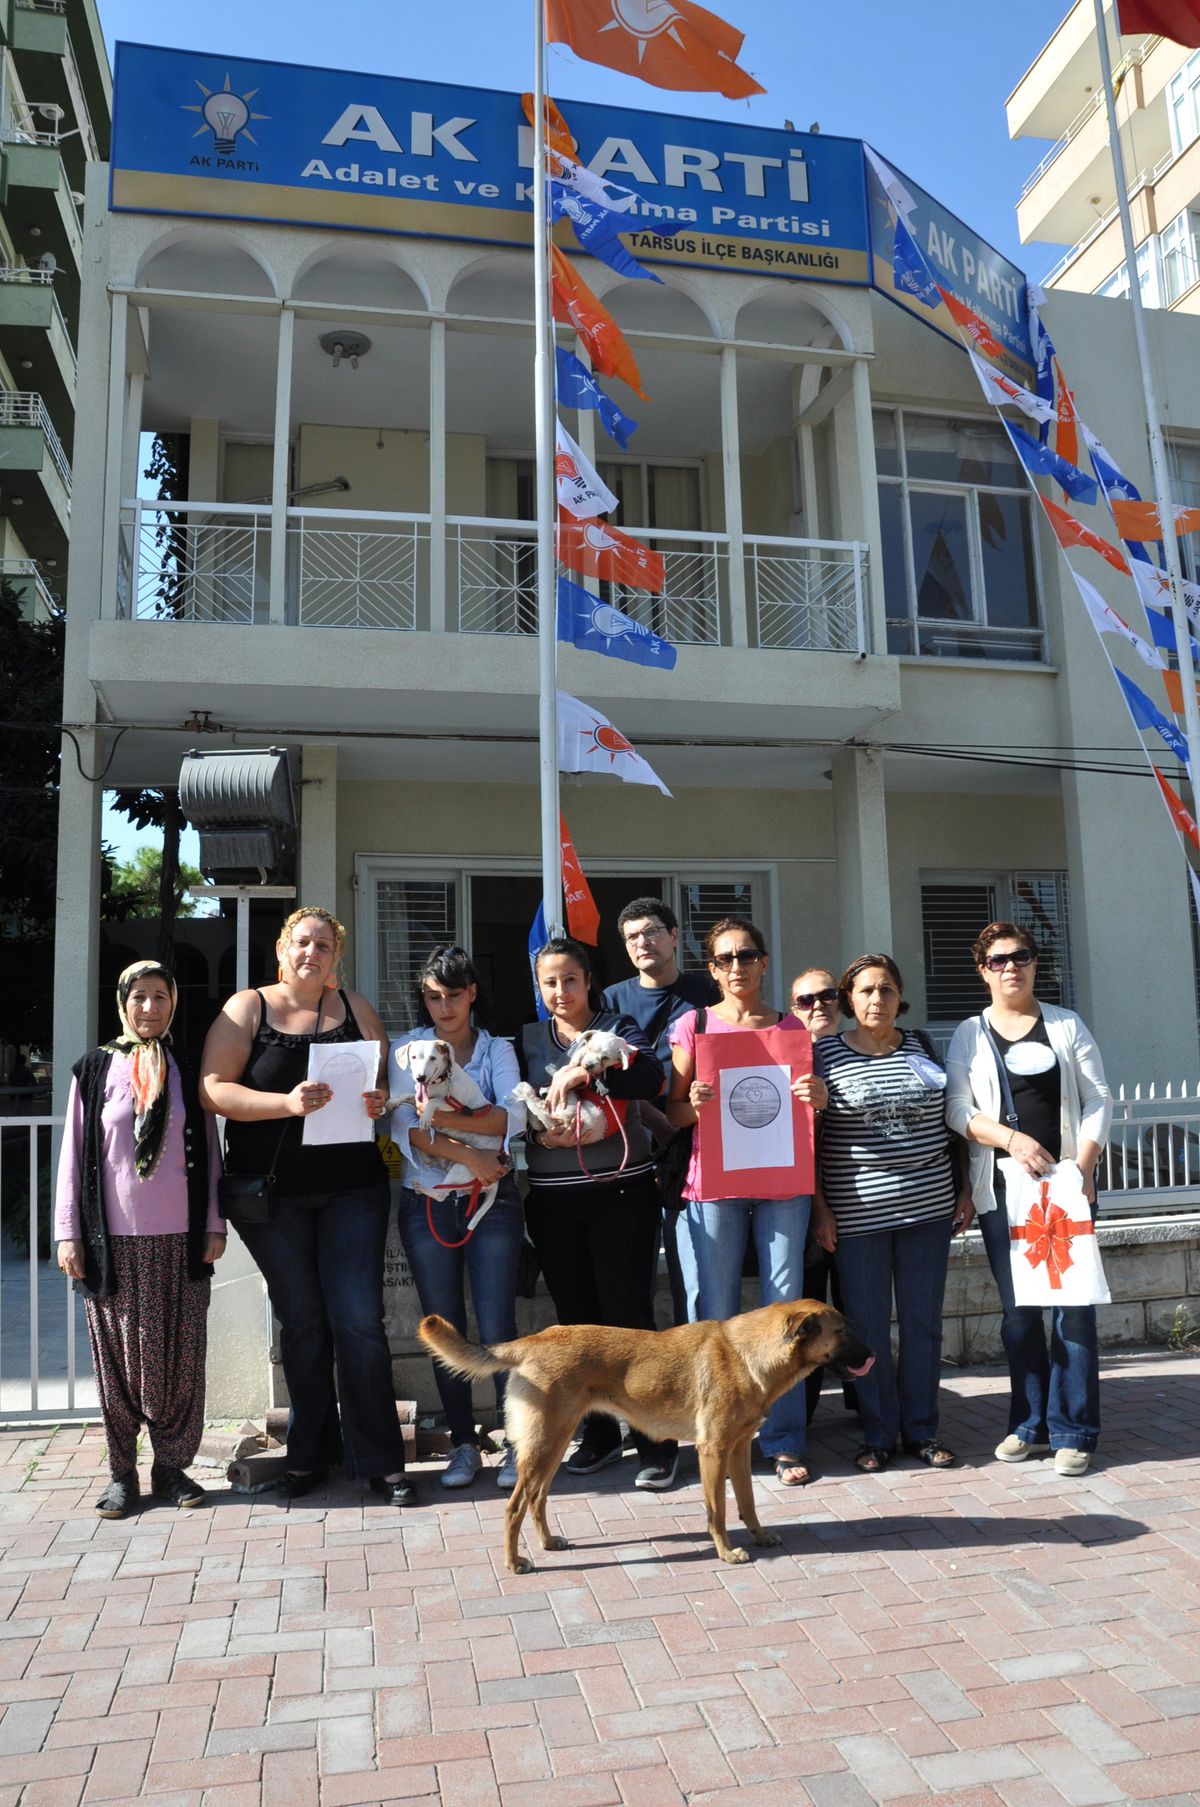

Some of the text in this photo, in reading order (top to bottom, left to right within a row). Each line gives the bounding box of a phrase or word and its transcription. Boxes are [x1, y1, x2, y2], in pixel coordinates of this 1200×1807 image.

[320, 103, 480, 163] AK
[190, 155, 212, 168] AK
[301, 159, 440, 192] Adalet
[454, 180, 500, 199] ve
[712, 207, 830, 238] Partisi
[629, 233, 840, 270] TARSUS İLÇE BAŞKANLIĞI
[927, 220, 958, 276] AK
